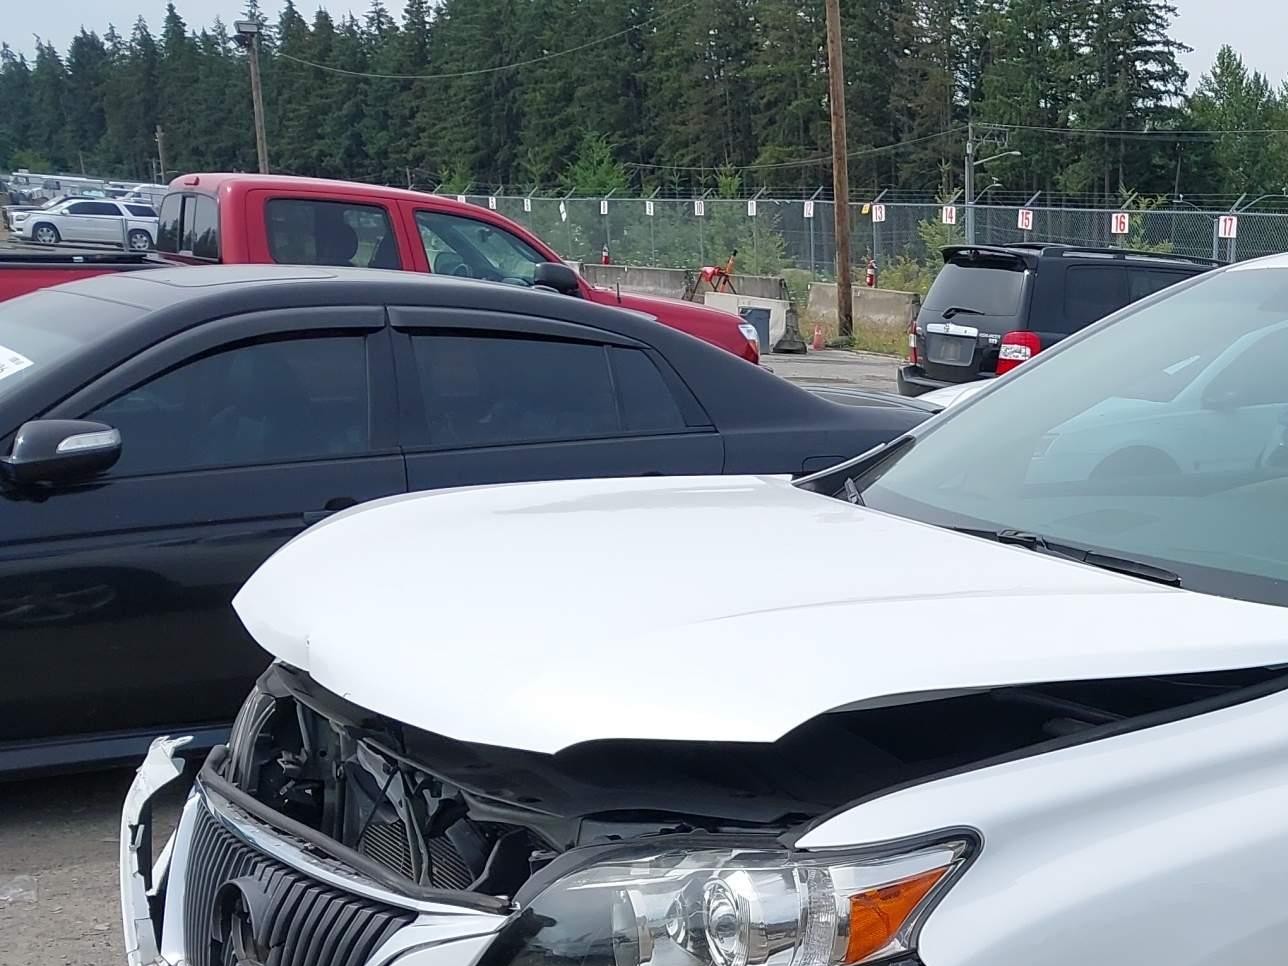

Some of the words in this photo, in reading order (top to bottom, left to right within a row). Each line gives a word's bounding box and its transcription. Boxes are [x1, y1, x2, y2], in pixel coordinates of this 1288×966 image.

[696, 201, 703, 214] 10
[874, 205, 883, 220] 13
[945, 207, 954, 222] 14
[1021, 211, 1030, 228] 15
[1115, 214, 1125, 232] 16
[1223, 217, 1233, 236] 17
